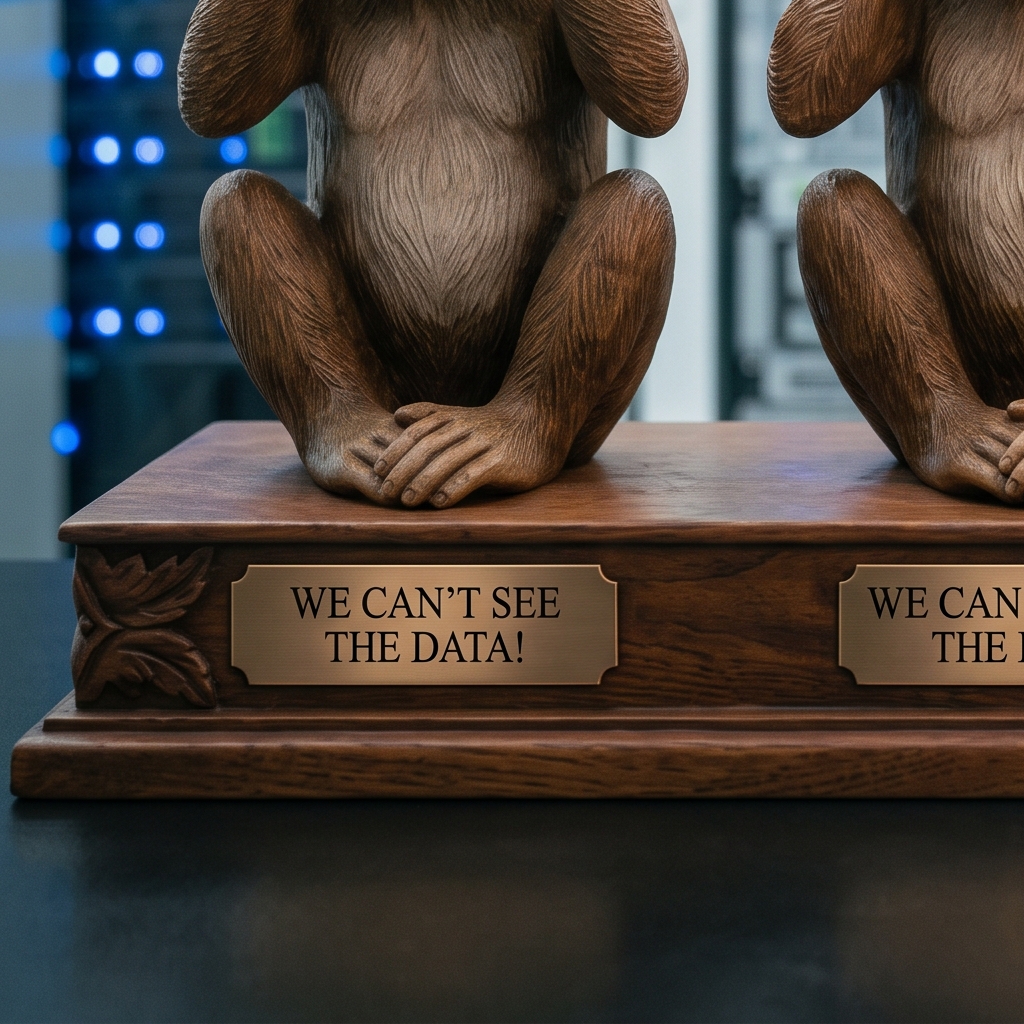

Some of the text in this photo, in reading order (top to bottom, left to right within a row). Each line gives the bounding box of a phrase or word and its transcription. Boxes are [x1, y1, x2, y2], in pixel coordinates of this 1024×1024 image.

[290, 586, 561, 619] WE CAN’T SEE
[867, 586, 929, 619] WE
[325, 631, 523, 663] THE DATA!
[931, 631, 1008, 663] THE
